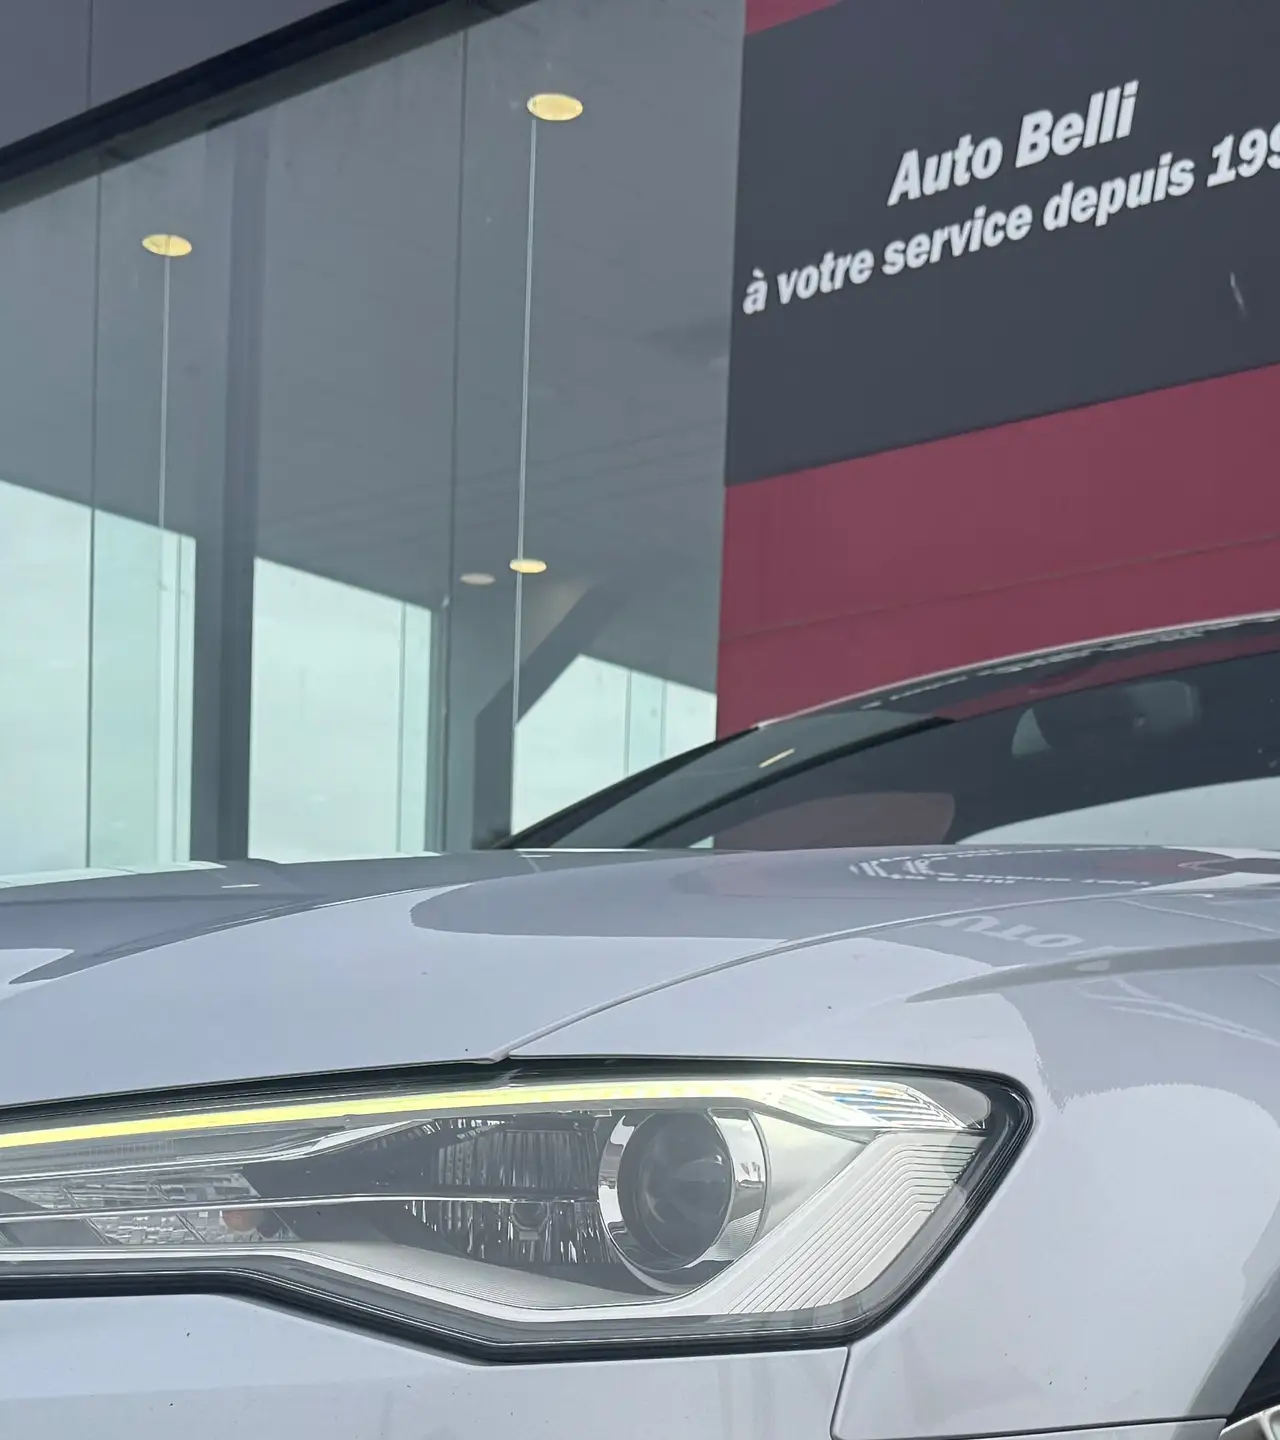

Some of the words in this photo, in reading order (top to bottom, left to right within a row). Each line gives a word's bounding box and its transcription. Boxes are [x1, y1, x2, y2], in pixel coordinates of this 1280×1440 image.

[887, 133, 1003, 206] Auto
[1015, 79, 1140, 169] Belli
[742, 268, 768, 315] à
[776, 249, 875, 304] votre
[881, 204, 1033, 275] service
[1042, 151, 1195, 230] depuis
